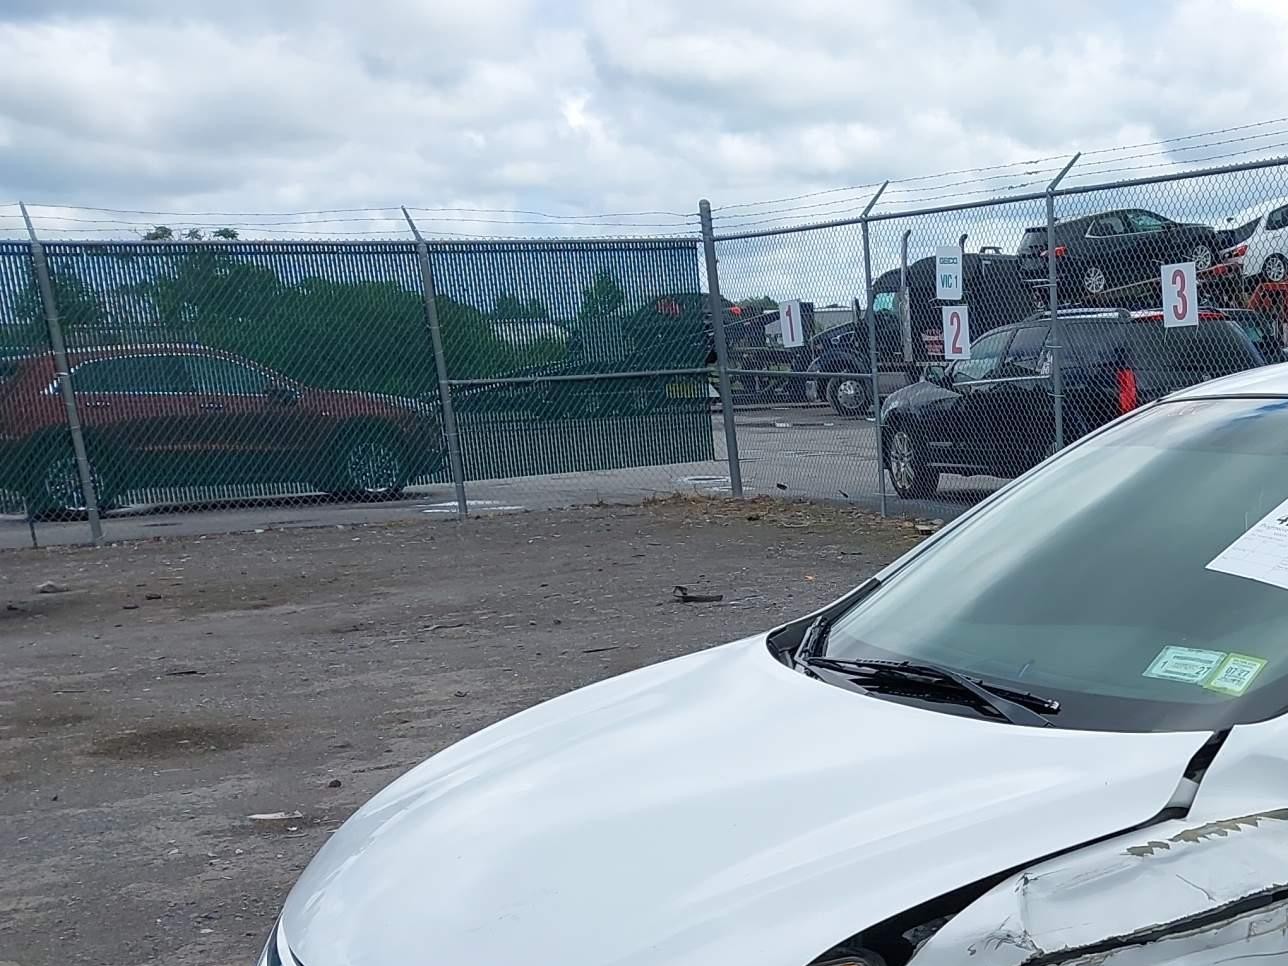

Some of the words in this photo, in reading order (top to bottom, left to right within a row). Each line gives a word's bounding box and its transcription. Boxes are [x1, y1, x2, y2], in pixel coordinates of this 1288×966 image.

[940, 273, 952, 289] VIC
[954, 274, 958, 289] 1
[1170, 269, 1189, 321] 3
[784, 305, 795, 341] 1
[949, 311, 963, 355] 2
[1195, 665, 1212, 676] 27
